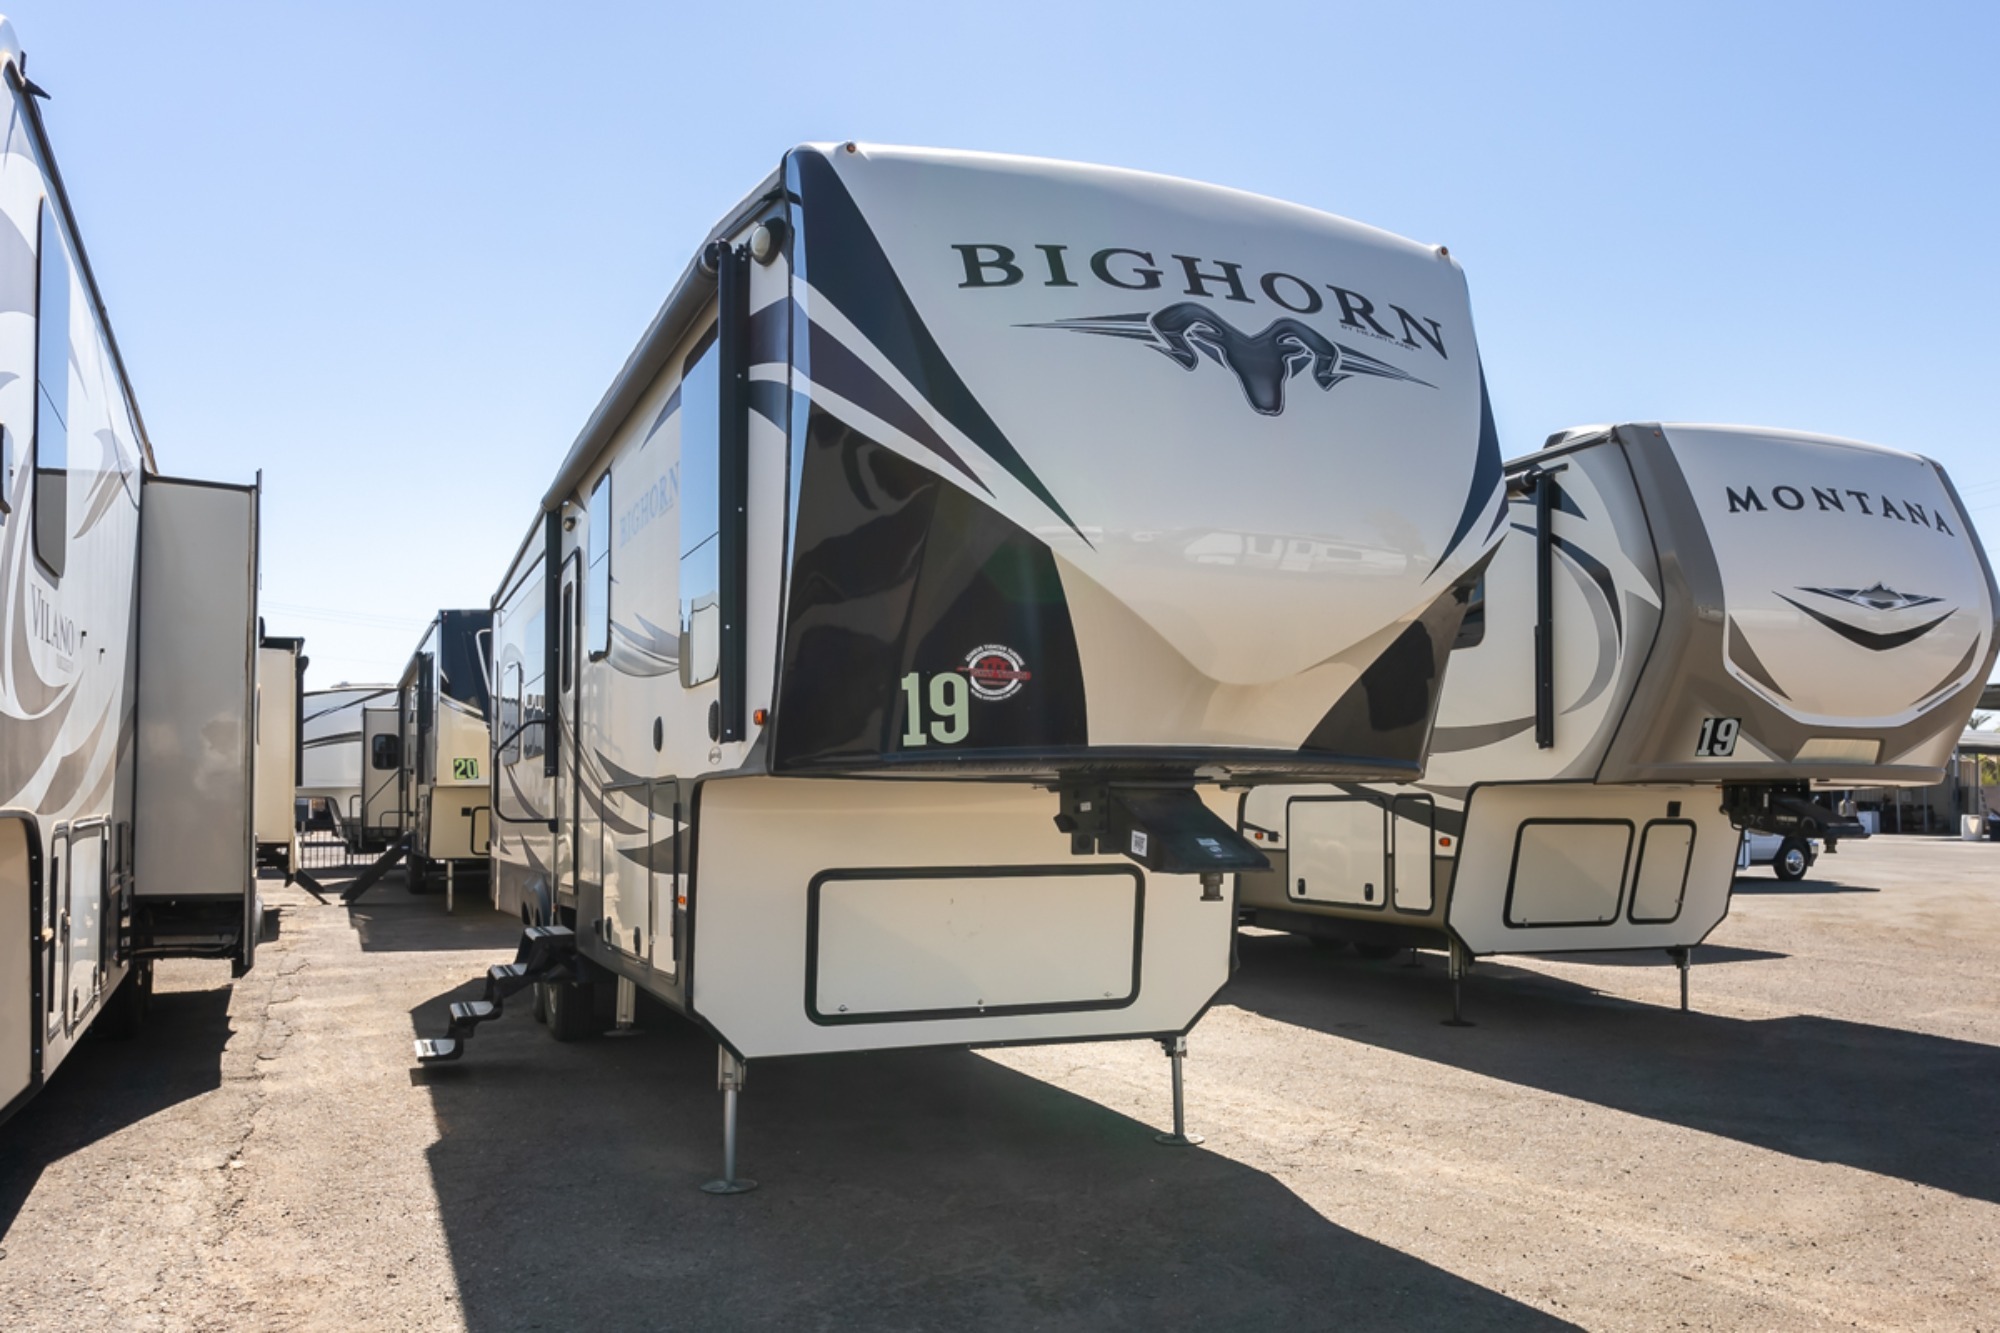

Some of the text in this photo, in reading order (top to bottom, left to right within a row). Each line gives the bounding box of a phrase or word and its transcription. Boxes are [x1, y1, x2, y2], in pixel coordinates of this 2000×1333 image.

[951, 244, 1448, 360] BIGHORN
[620, 461, 680, 548] BIGHORN
[1726, 485, 1955, 537] MONTANA
[31, 582, 75, 657] VILANO
[901, 672, 969, 747] 19
[1697, 718, 1739, 756] 19
[454, 759, 478, 779] 20
